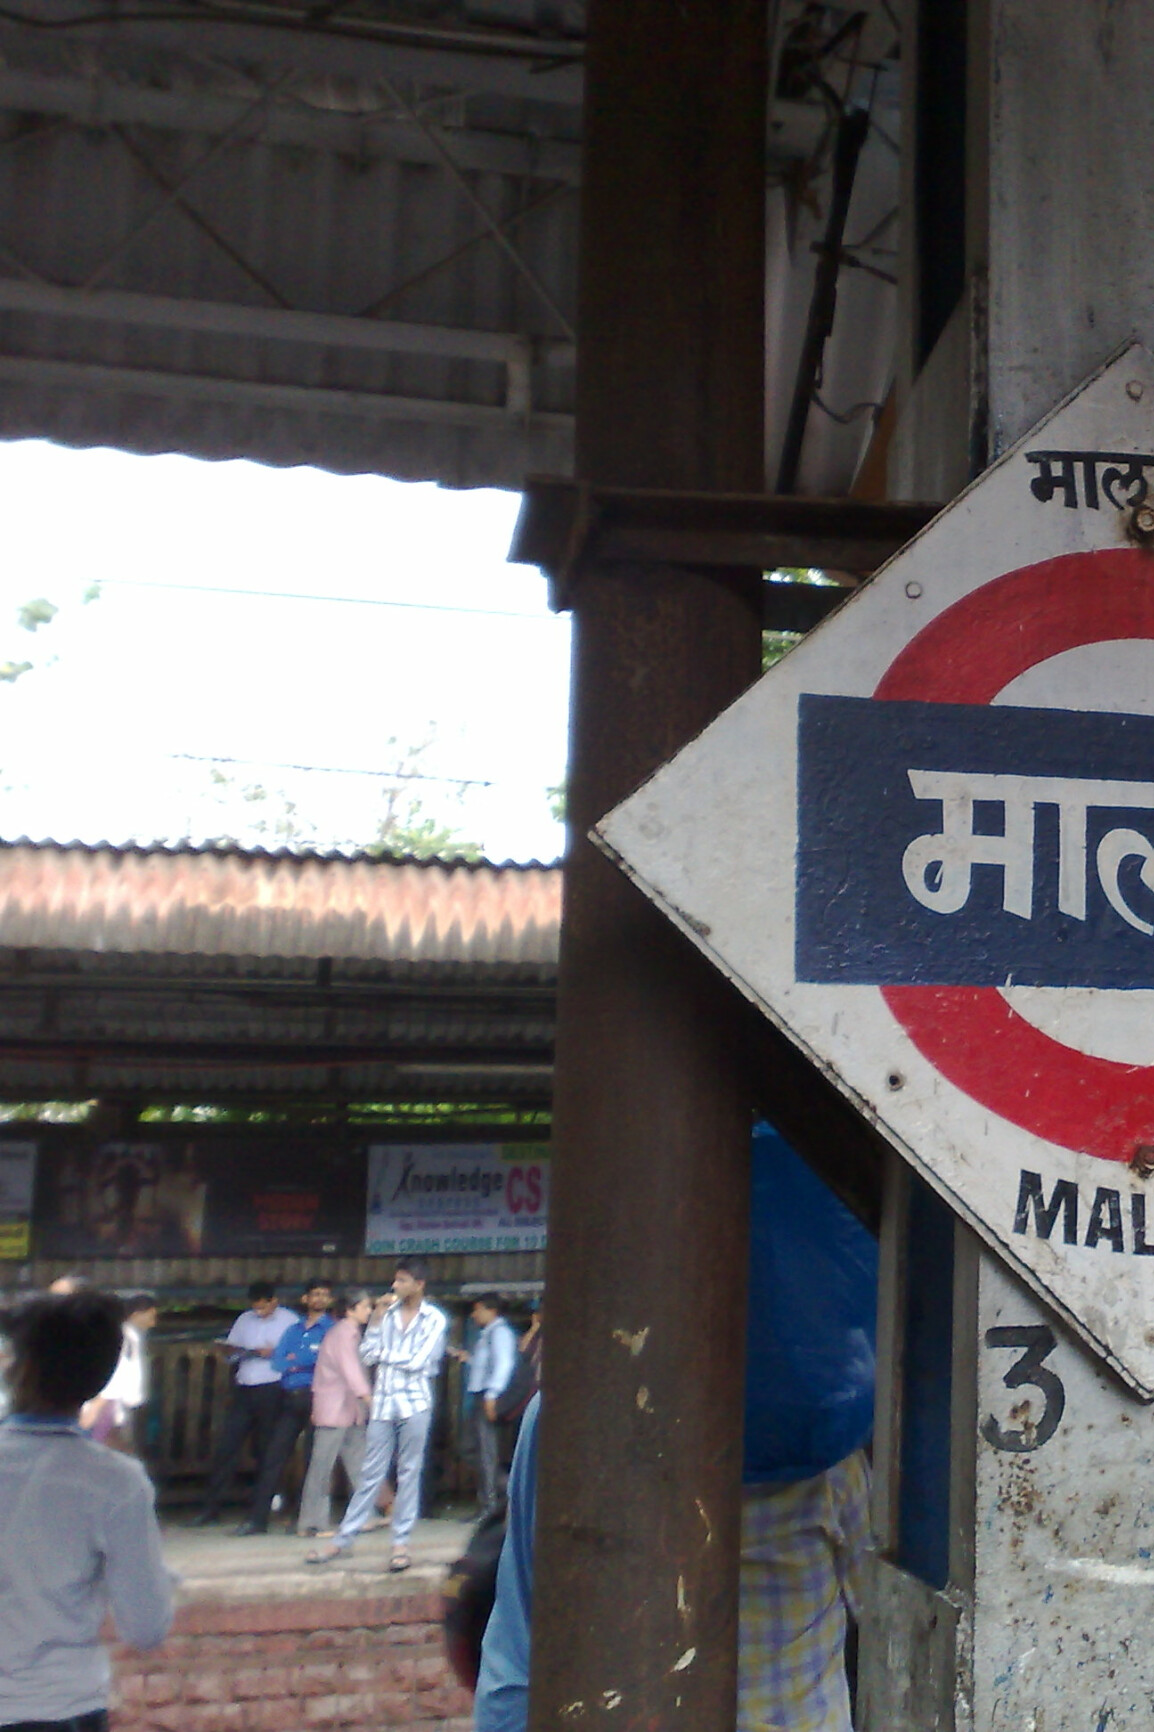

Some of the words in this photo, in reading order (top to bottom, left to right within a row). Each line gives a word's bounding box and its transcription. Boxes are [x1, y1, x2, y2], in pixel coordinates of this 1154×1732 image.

[392, 1152, 503, 1201] Knowledge
[506, 1166, 542, 1214] CS
[980, 1325, 1065, 1453] 3
